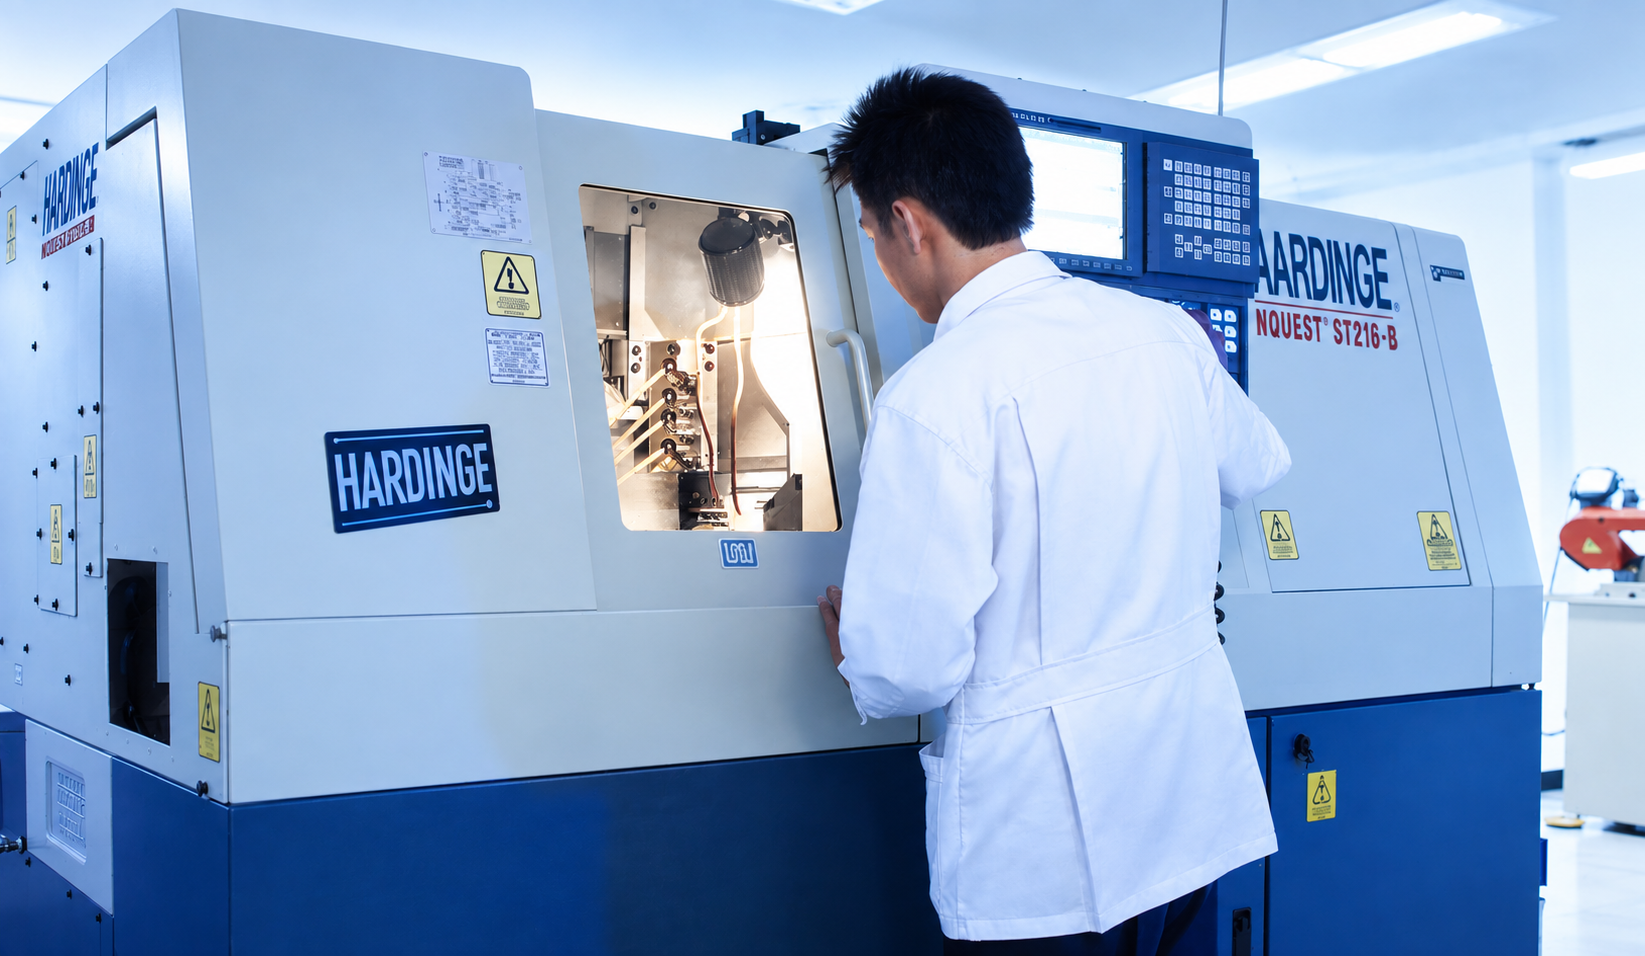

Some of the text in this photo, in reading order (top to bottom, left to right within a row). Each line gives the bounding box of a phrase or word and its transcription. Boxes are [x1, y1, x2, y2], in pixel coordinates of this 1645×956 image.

[42, 142, 99, 236] HARDINGE
[1256, 308, 1398, 351] NQUEST ST216-B
[334, 443, 493, 512] HARDINGE
